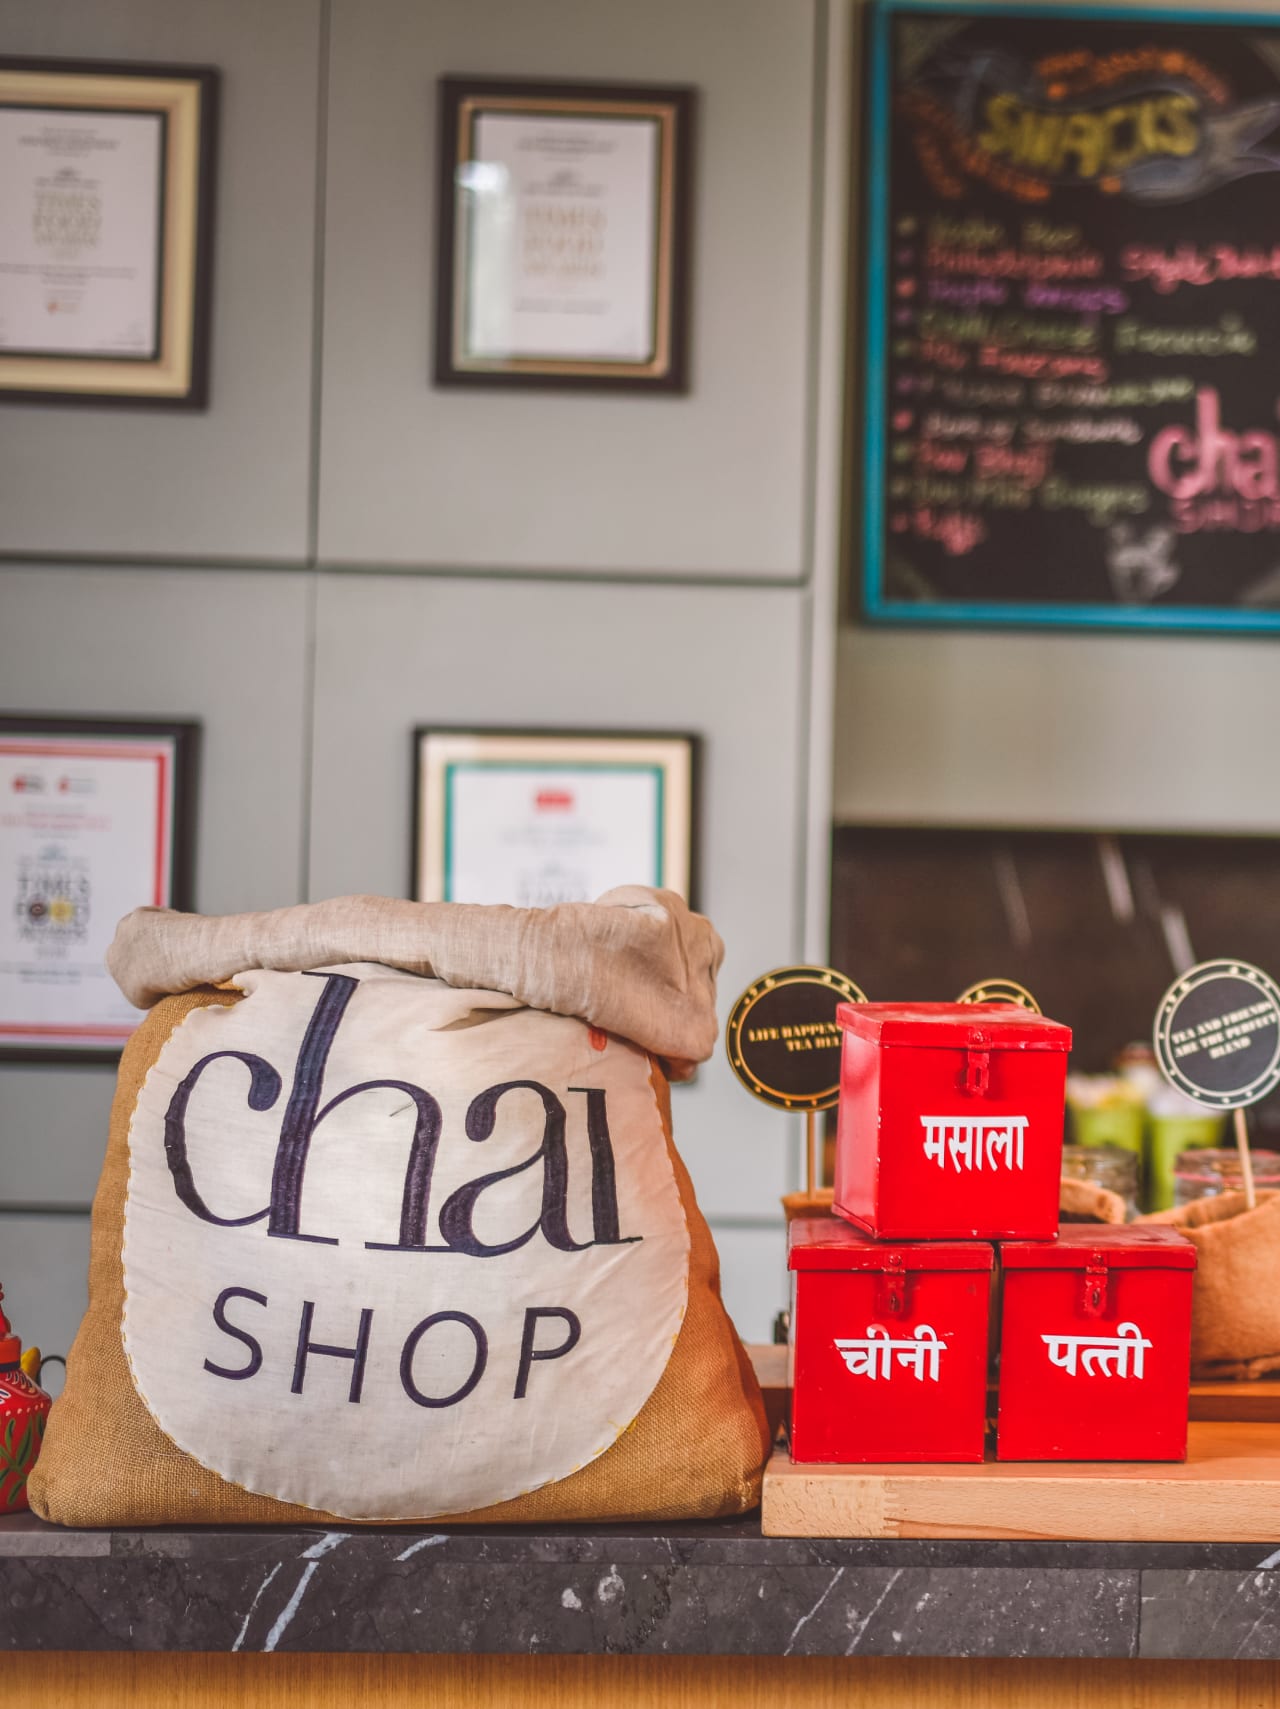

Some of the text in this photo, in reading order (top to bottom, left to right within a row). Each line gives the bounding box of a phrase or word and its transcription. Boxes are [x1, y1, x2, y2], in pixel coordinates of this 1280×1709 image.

[749, 1028, 779, 1042] LIFE
[786, 1039, 812, 1052] TEA
[1171, 1028, 1196, 1044] TEA
[1197, 1019, 1222, 1034] AND
[1175, 1041, 1200, 1058] ARE
[1200, 1032, 1224, 1048] THE
[164, 970, 643, 1257] chai
[920, 1115, 1029, 1173] मसाला
[204, 1286, 582, 1409] SHOP
[834, 1324, 947, 1382] चीनी
[1040, 1321, 1153, 1379] पत्ती
